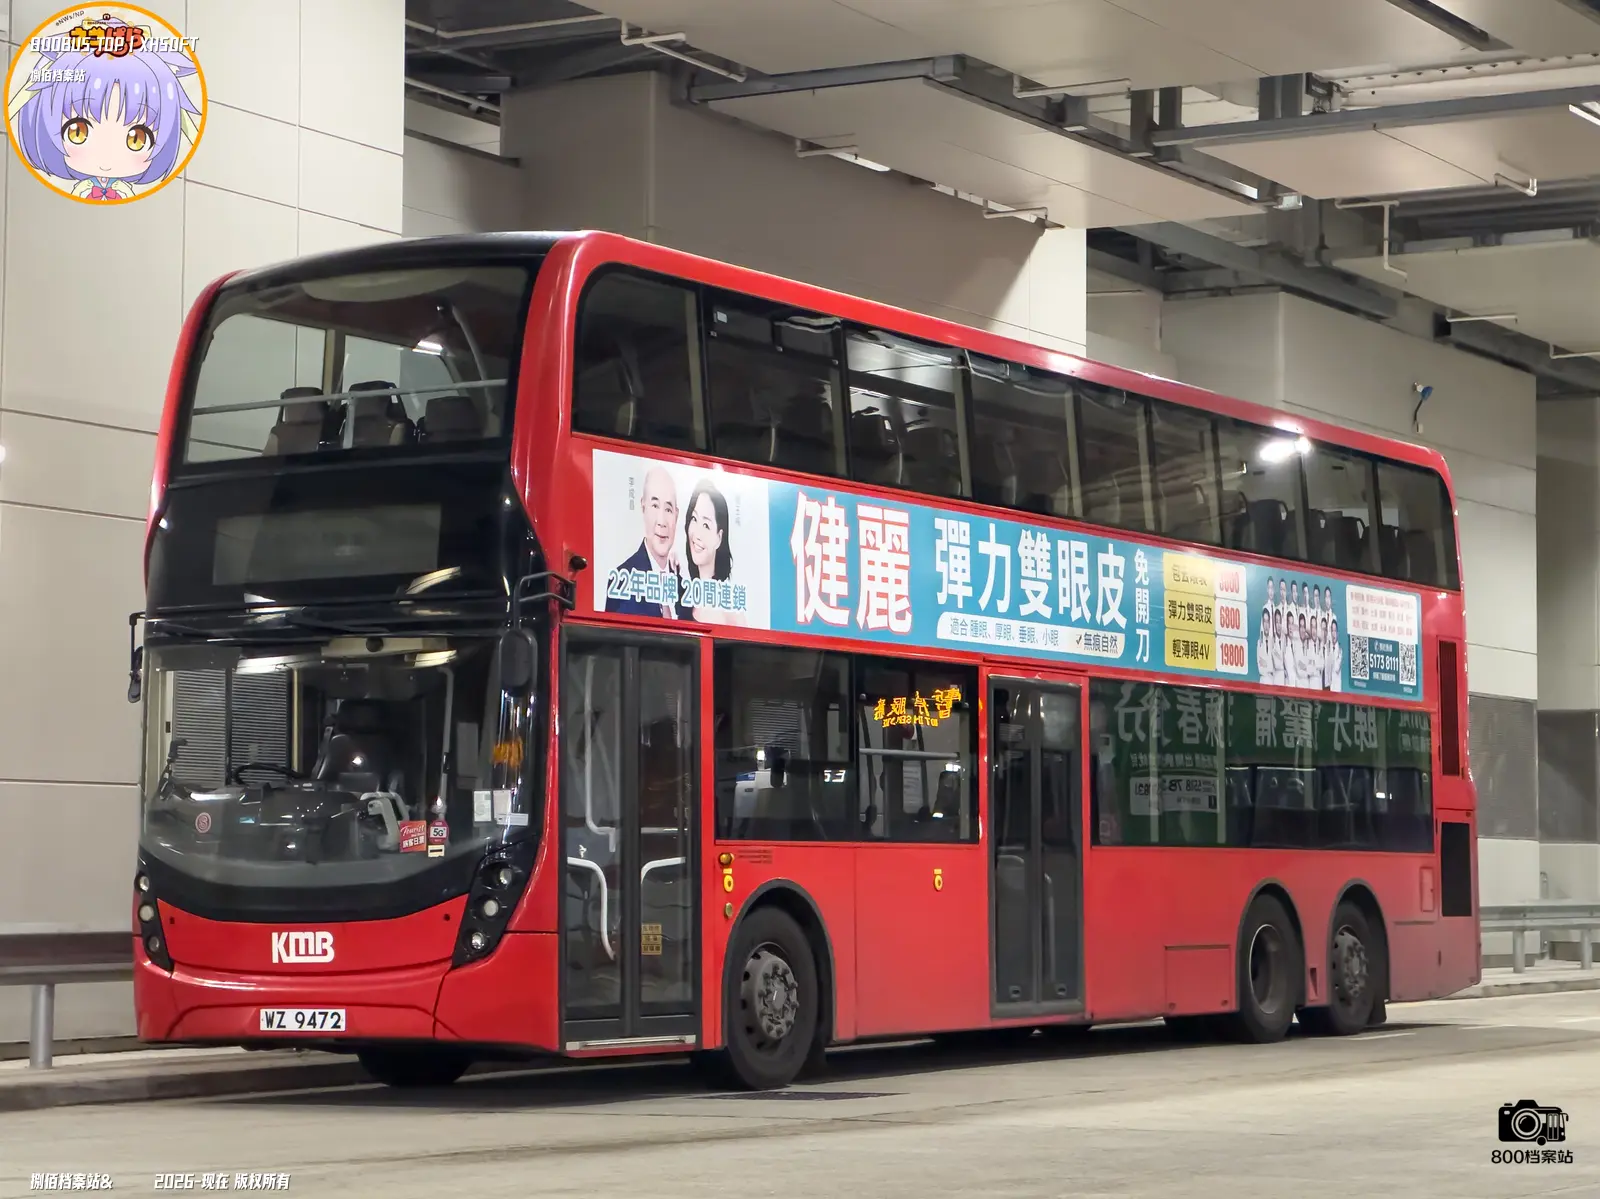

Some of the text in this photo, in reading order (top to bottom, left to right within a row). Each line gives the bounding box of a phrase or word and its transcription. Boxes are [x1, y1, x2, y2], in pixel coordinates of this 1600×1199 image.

[790, 491, 912, 634] 健麗
[935, 517, 1128, 629] 彈力雙眼皮
[608, 569, 748, 612] 22年品牌 20間連鎖
[1134, 548, 1150, 663] 免開刀
[1168, 600, 1241, 630] 彈力雙眼皮 6800
[1083, 631, 1119, 654] 無痕自然
[1172, 638, 1245, 668] 輕薄眼4V 19800
[1369, 654, 1399, 671] 5173 8111
[271, 931, 335, 964] KMB
[264, 1010, 342, 1030] WZ 9472
